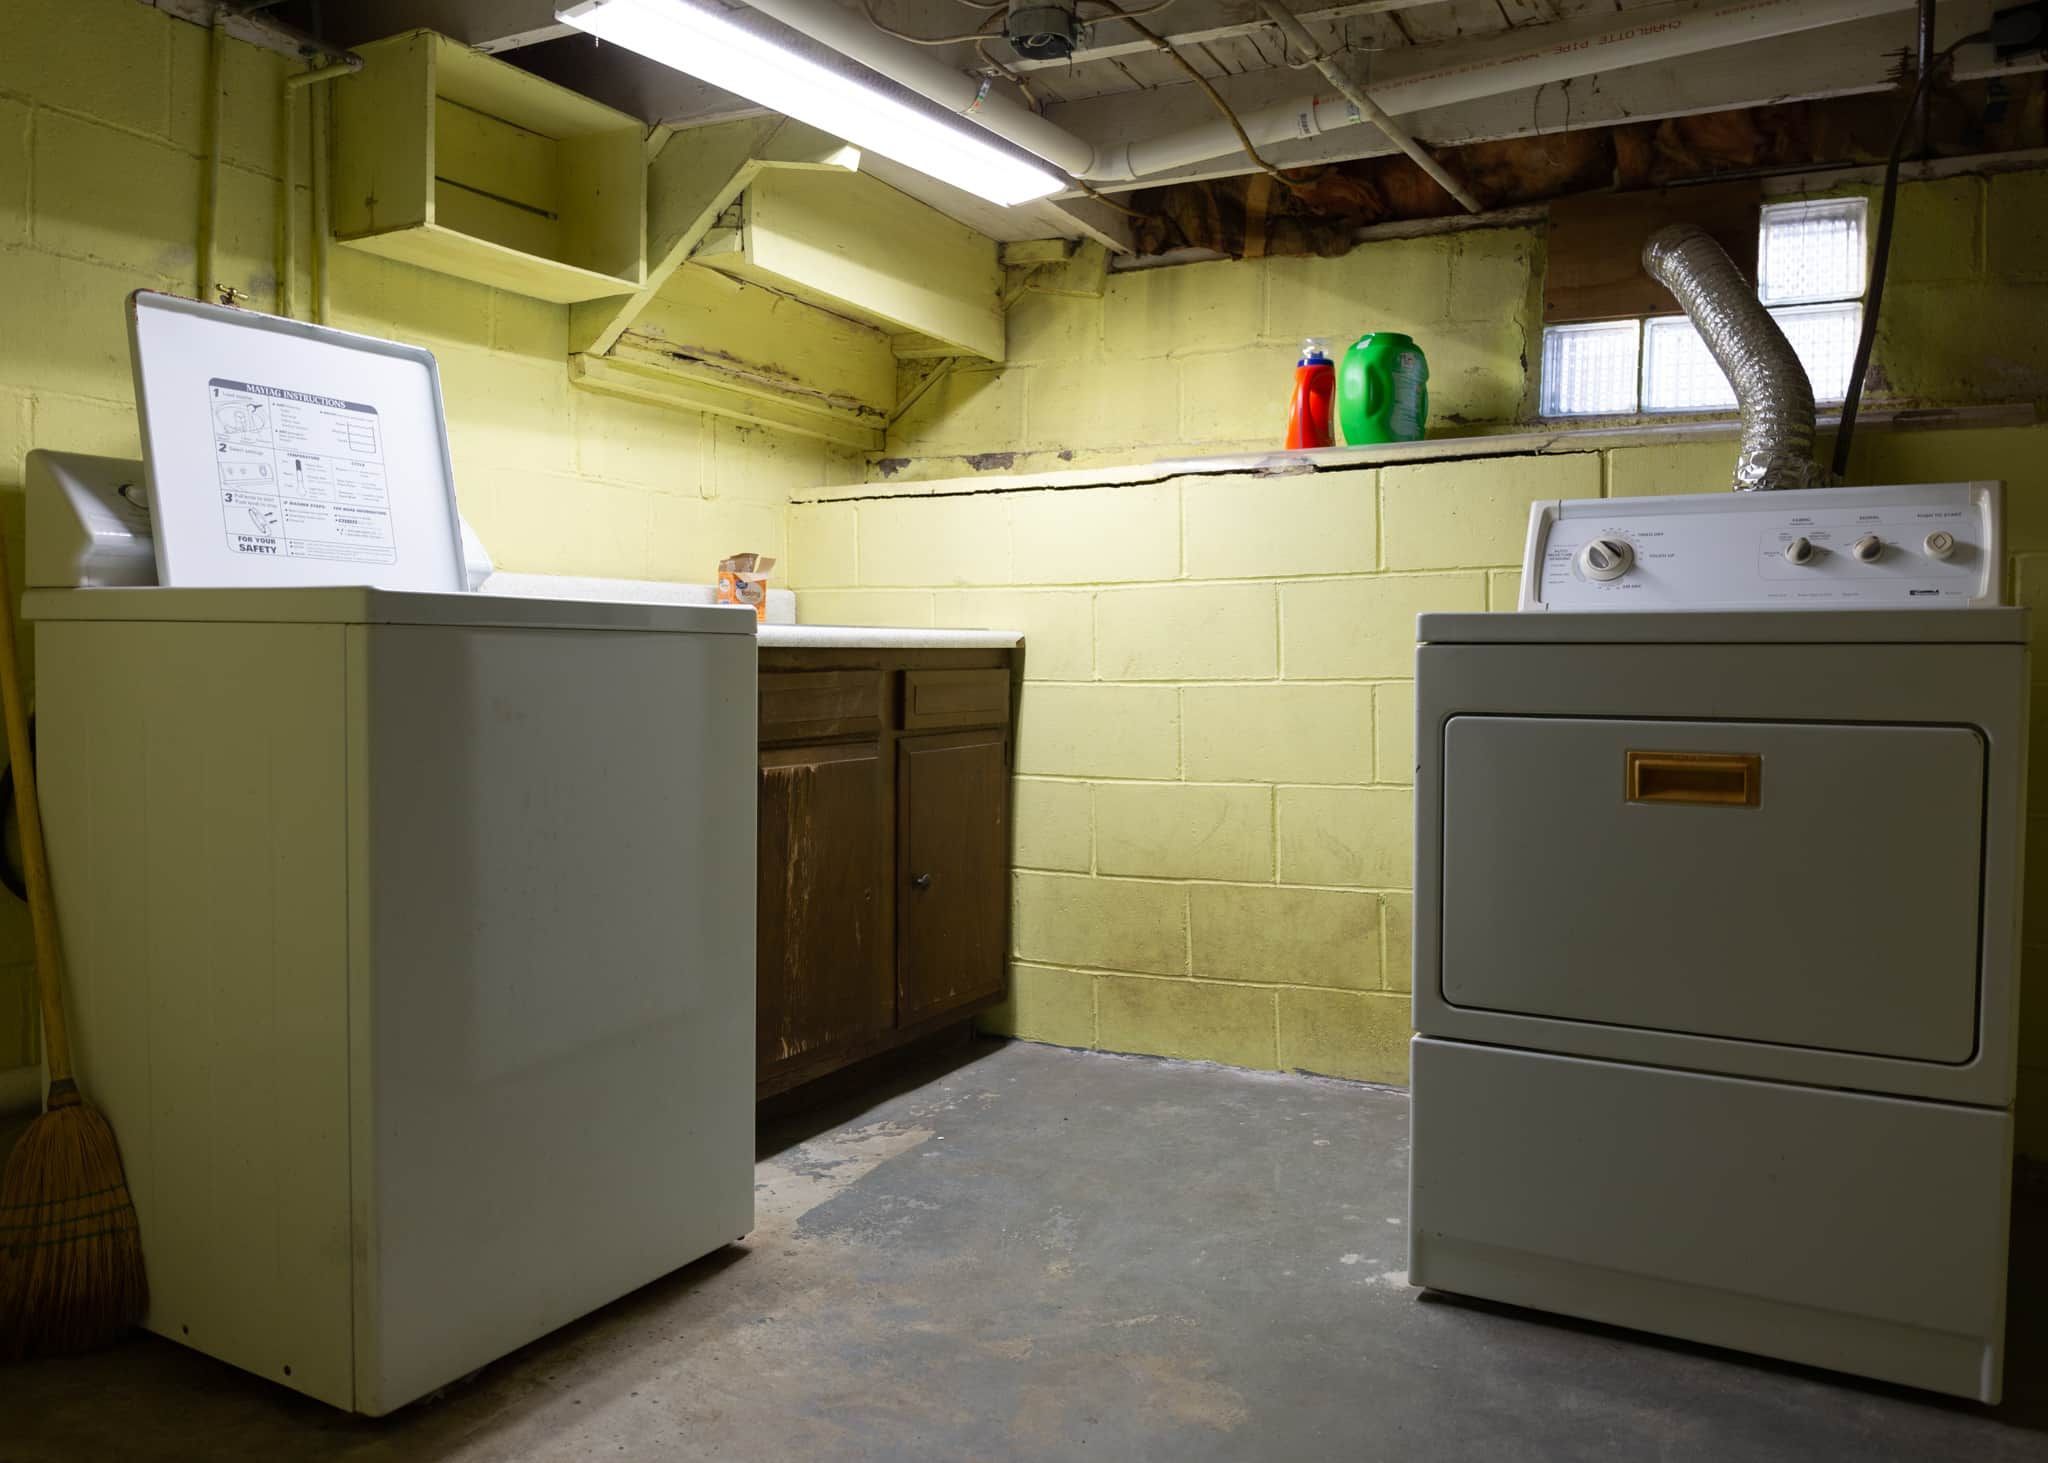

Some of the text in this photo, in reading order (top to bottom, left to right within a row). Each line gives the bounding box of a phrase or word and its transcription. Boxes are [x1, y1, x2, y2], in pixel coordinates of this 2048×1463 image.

[1551, 20, 1681, 55] CHARLOTTE PIPE
[213, 388, 219, 398] 1
[246, 383, 281, 397] MAYTAG
[283, 389, 346, 409] INSTRUCTIONS
[218, 443, 227, 453] 2
[224, 493, 233, 503] 3
[239, 543, 277, 554] SAFETY
